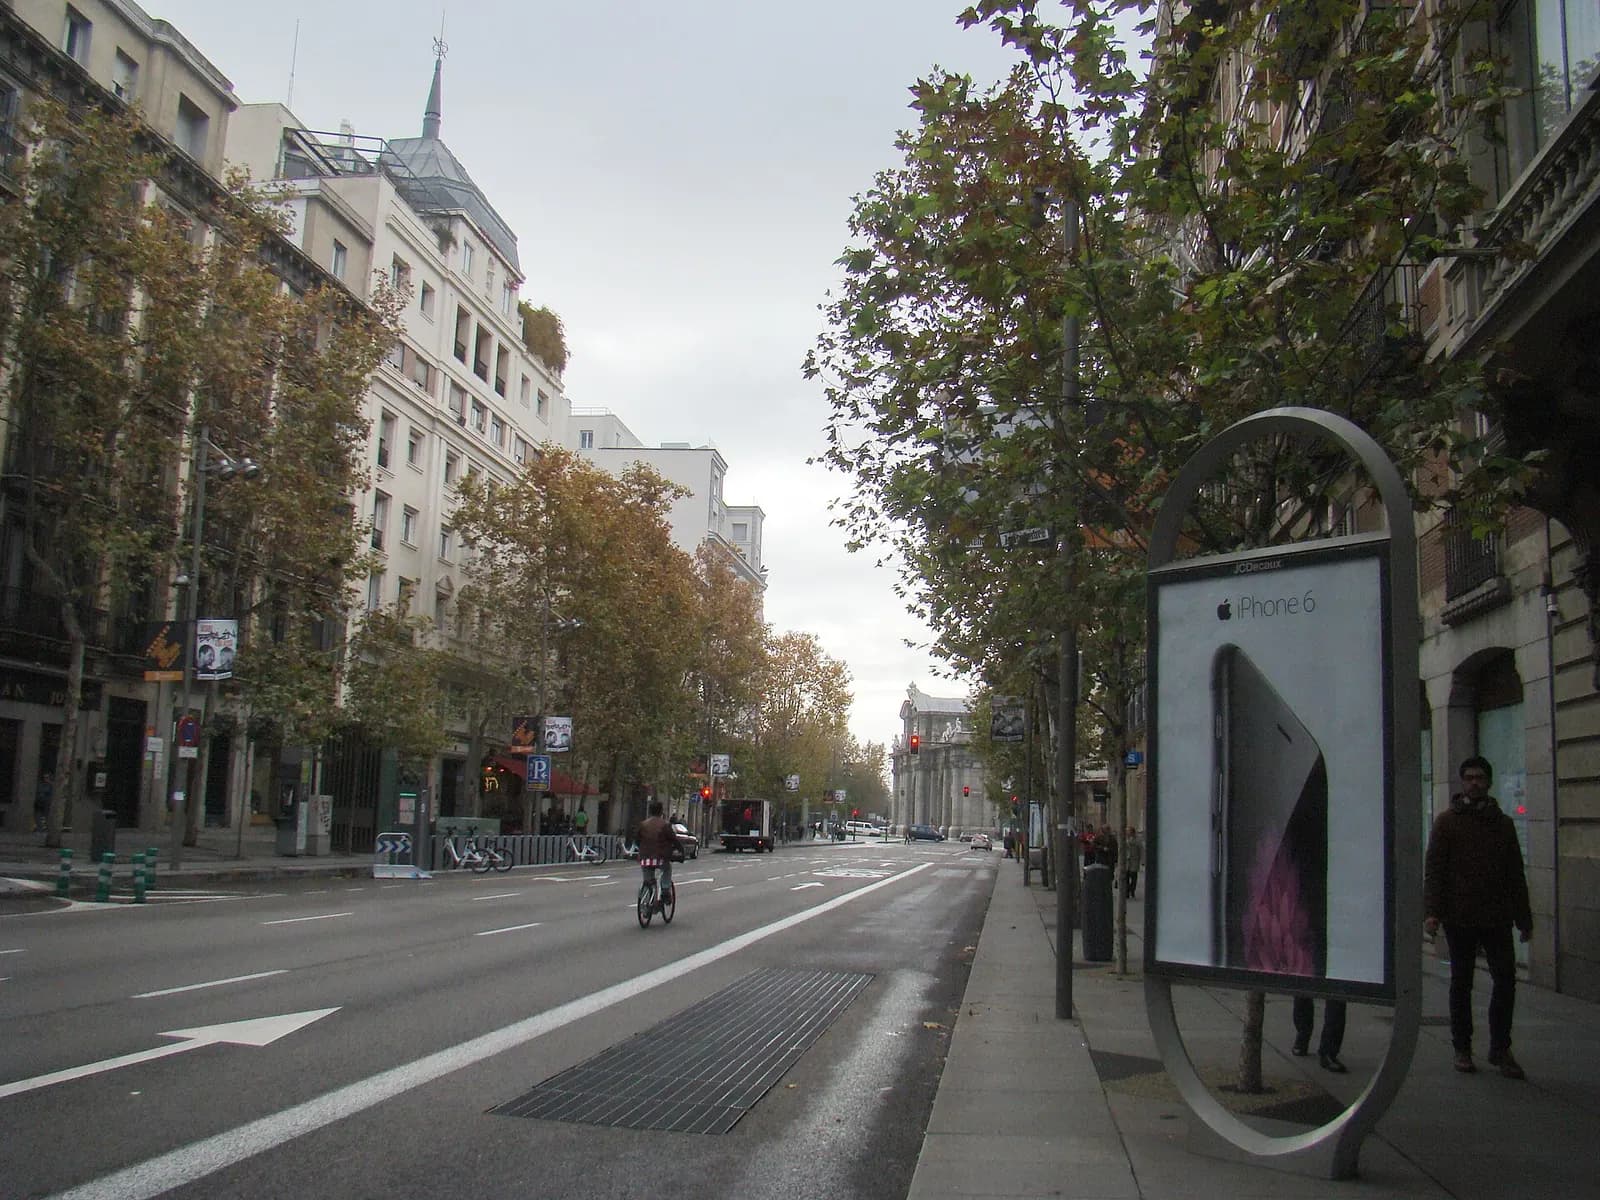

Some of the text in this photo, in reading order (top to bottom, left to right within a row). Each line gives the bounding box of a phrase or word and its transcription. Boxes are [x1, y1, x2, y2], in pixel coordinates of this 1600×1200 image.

[1234, 560, 1281, 574] JCDecaux
[1237, 590, 1316, 620] iPhone 6
[534, 760, 547, 780] P
